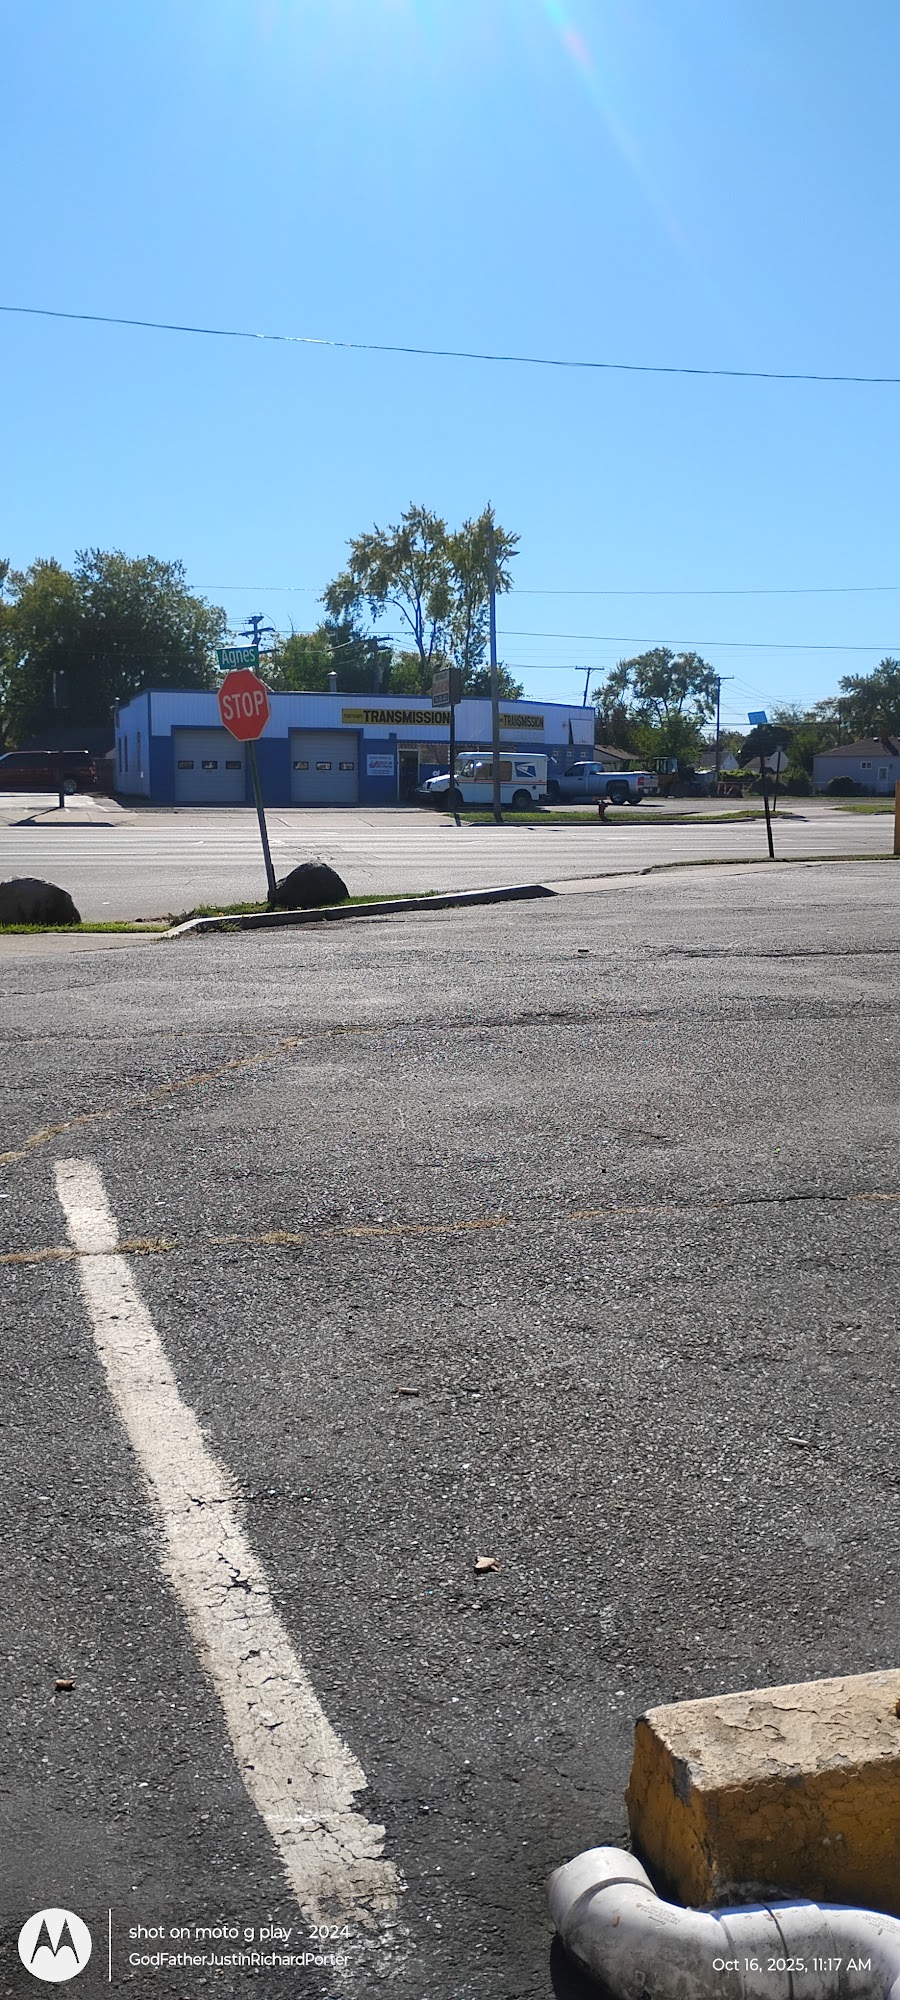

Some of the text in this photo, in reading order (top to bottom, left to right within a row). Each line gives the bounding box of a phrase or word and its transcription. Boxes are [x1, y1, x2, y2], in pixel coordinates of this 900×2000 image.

[222, 648, 256, 667] Agnes
[222, 690, 264, 720] STOP
[363, 710, 450, 724] TRANSMISSION
[504, 714, 544, 728] TRANSMISSION
